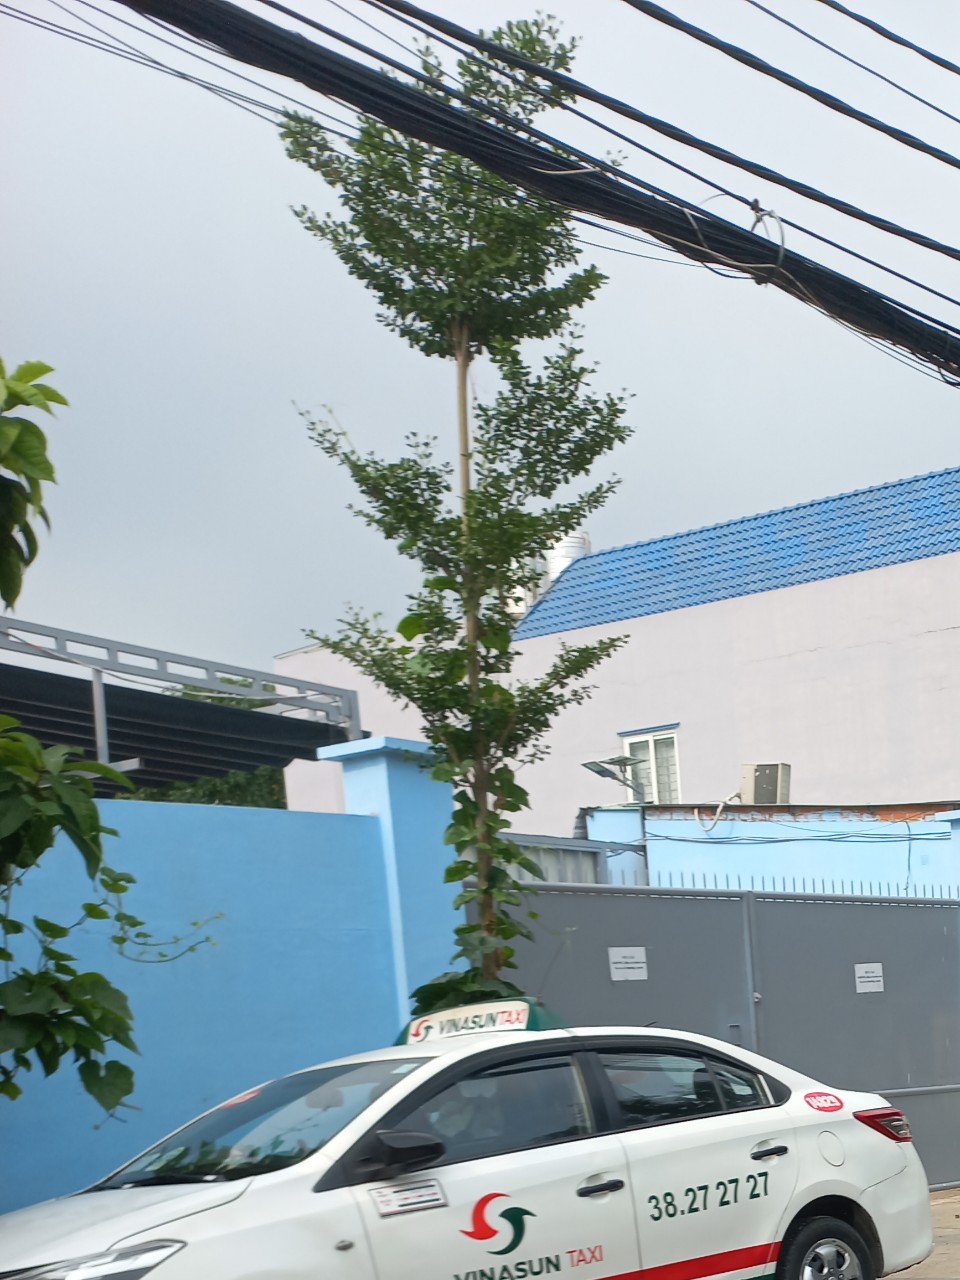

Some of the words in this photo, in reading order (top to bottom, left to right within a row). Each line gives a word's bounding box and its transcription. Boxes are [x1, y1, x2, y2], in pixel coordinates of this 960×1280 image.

[438, 1012, 499, 1034] VINASUN
[497, 1008, 527, 1026] TAXI
[647, 1184, 709, 1222] 38.27
[715, 1178, 740, 1207] 27
[745, 1171, 769, 1200] 27
[565, 1244, 604, 1268] TAXI
